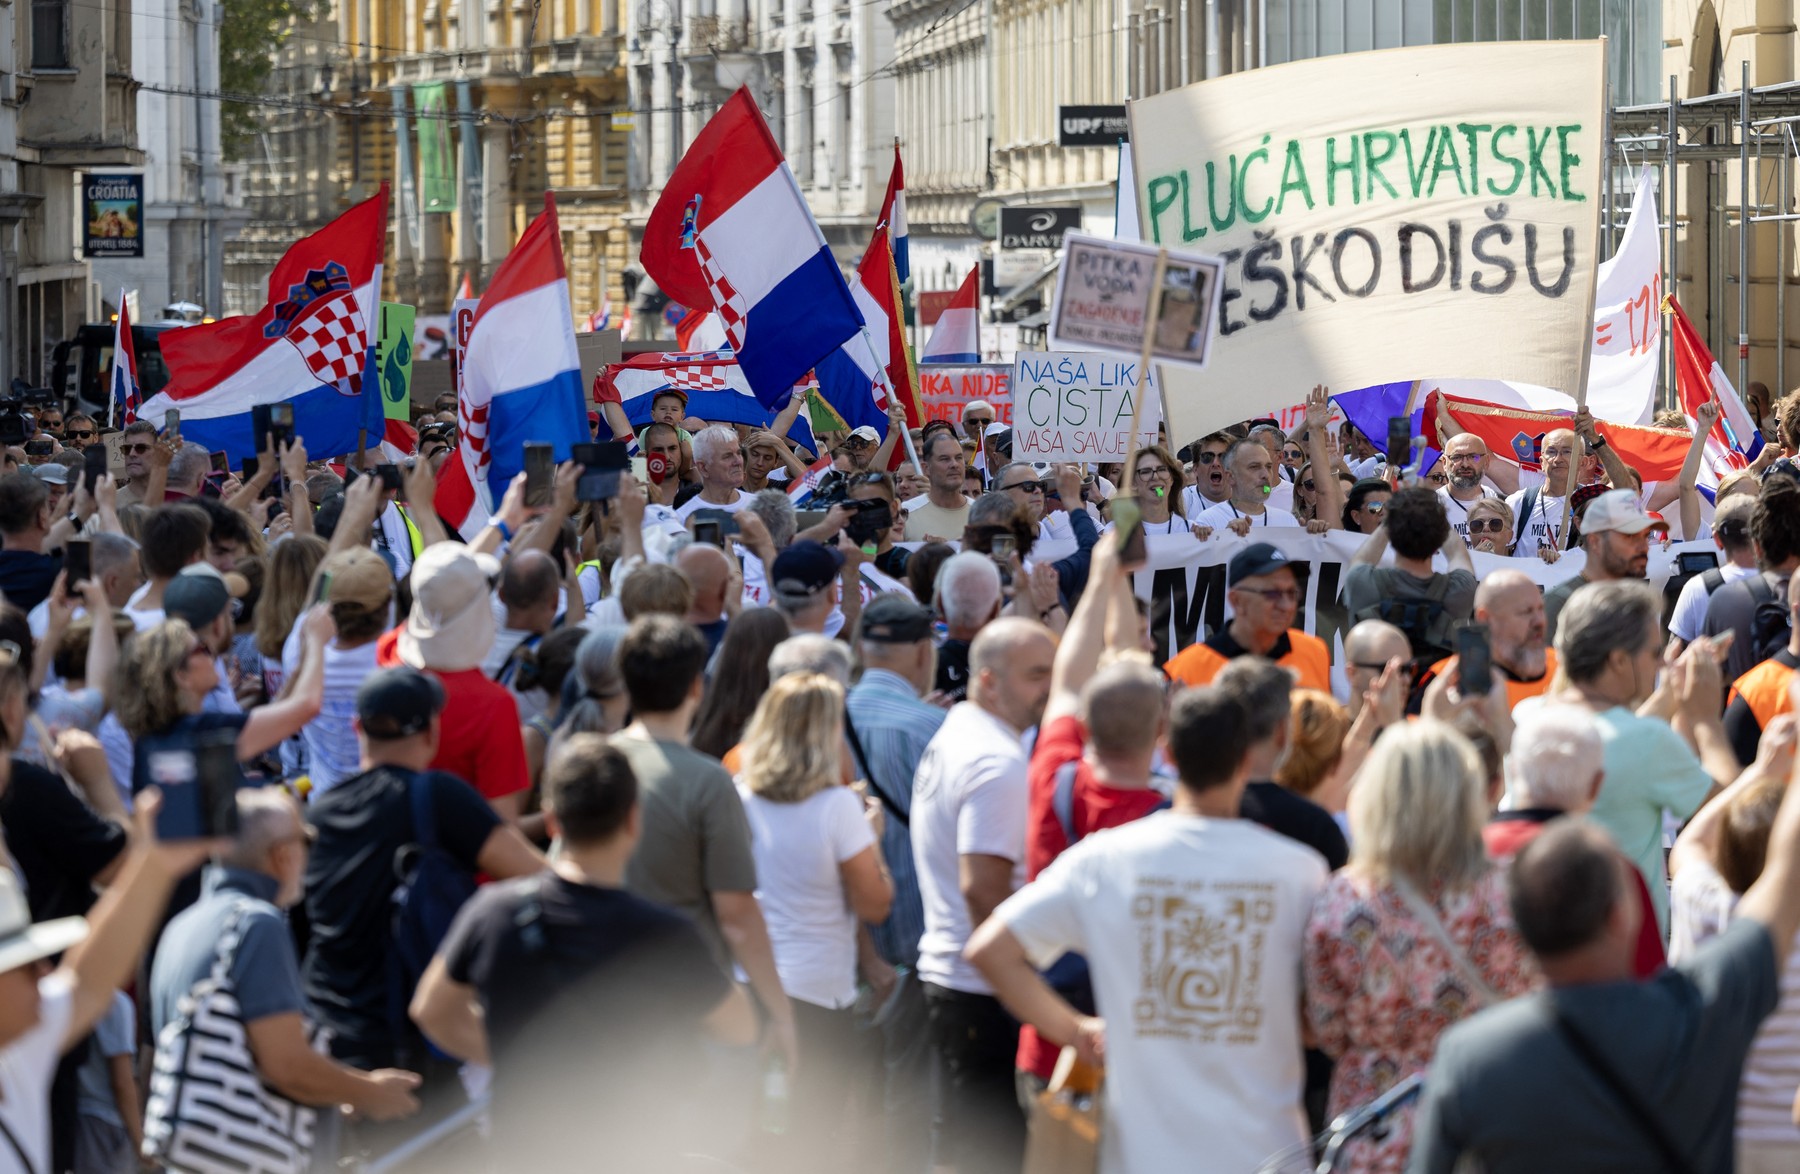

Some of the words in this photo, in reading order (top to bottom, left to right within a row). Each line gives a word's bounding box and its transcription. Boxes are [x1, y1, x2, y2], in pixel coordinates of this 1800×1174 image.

[87, 185, 138, 200] CROATIA
[1148, 134, 1315, 245] PLUĆA
[1326, 123, 1587, 206] HRVATSKE
[1075, 251, 1142, 277] PITKA
[1219, 228, 1382, 336] EŠKO
[1397, 203, 1576, 298] DIŠU
[1084, 273, 1135, 294] VODA
[921, 373, 954, 395] IKA
[962, 374, 1009, 397] NIJE
[1020, 357, 1089, 385] NAŠA
[1100, 362, 1153, 387] LIKA
[1028, 385, 1138, 428] ČISTA
[1017, 428, 1064, 453] VAŠA
